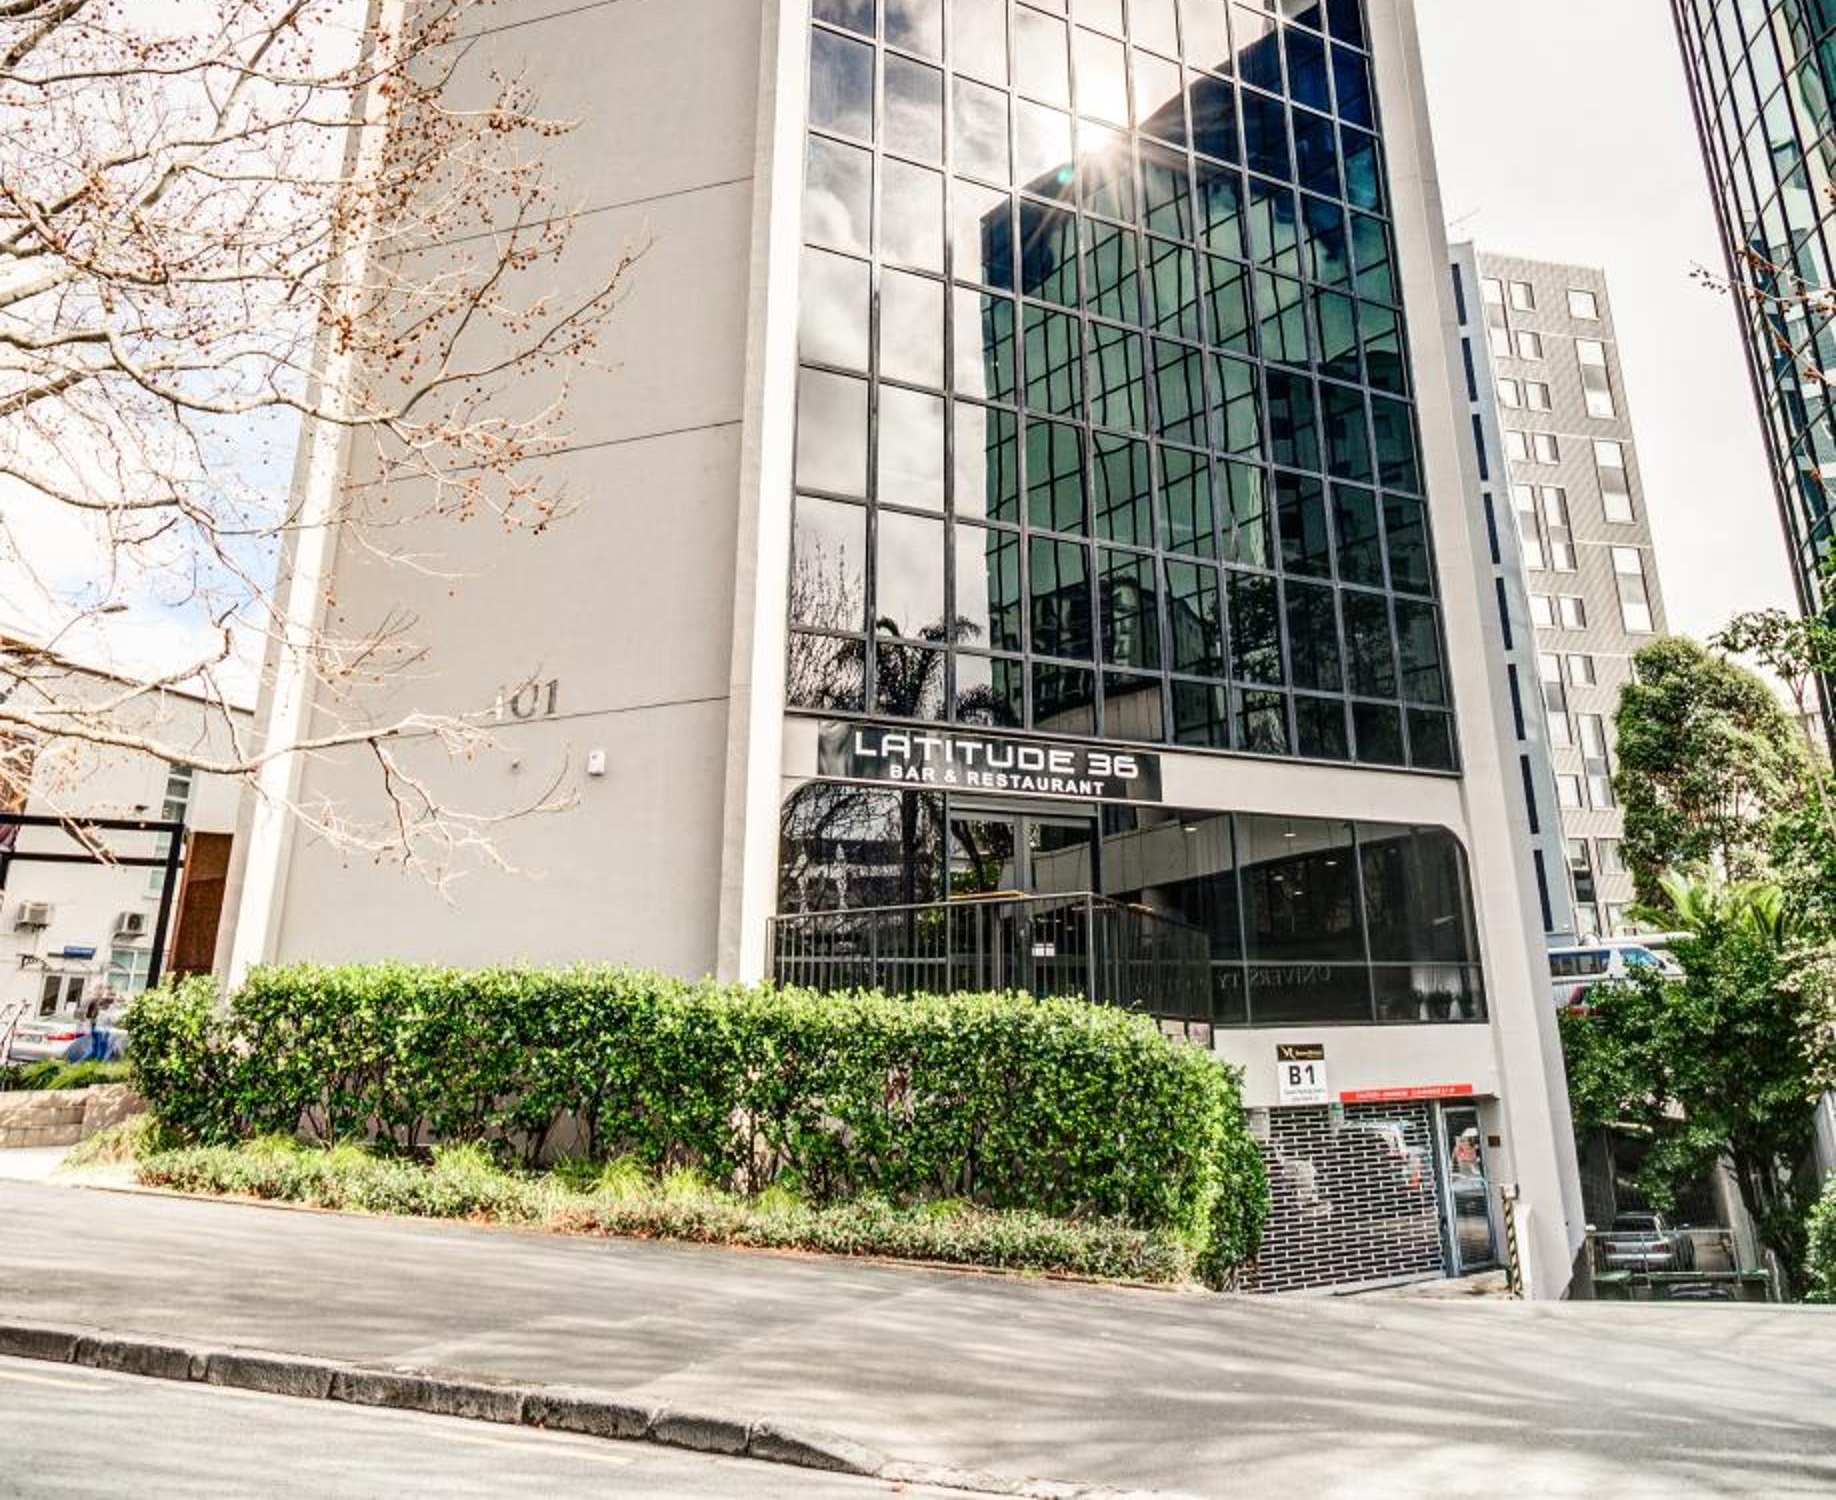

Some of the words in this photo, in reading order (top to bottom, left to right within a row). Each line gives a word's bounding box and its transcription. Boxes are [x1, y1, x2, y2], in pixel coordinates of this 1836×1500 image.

[854, 730, 1075, 774] LATITUDE
[1087, 753, 1139, 779] 36
[890, 764, 935, 782] BAR
[943, 768, 957, 784] &
[967, 770, 1105, 796] RESTAURANT
[1288, 1064, 1315, 1086] B1
